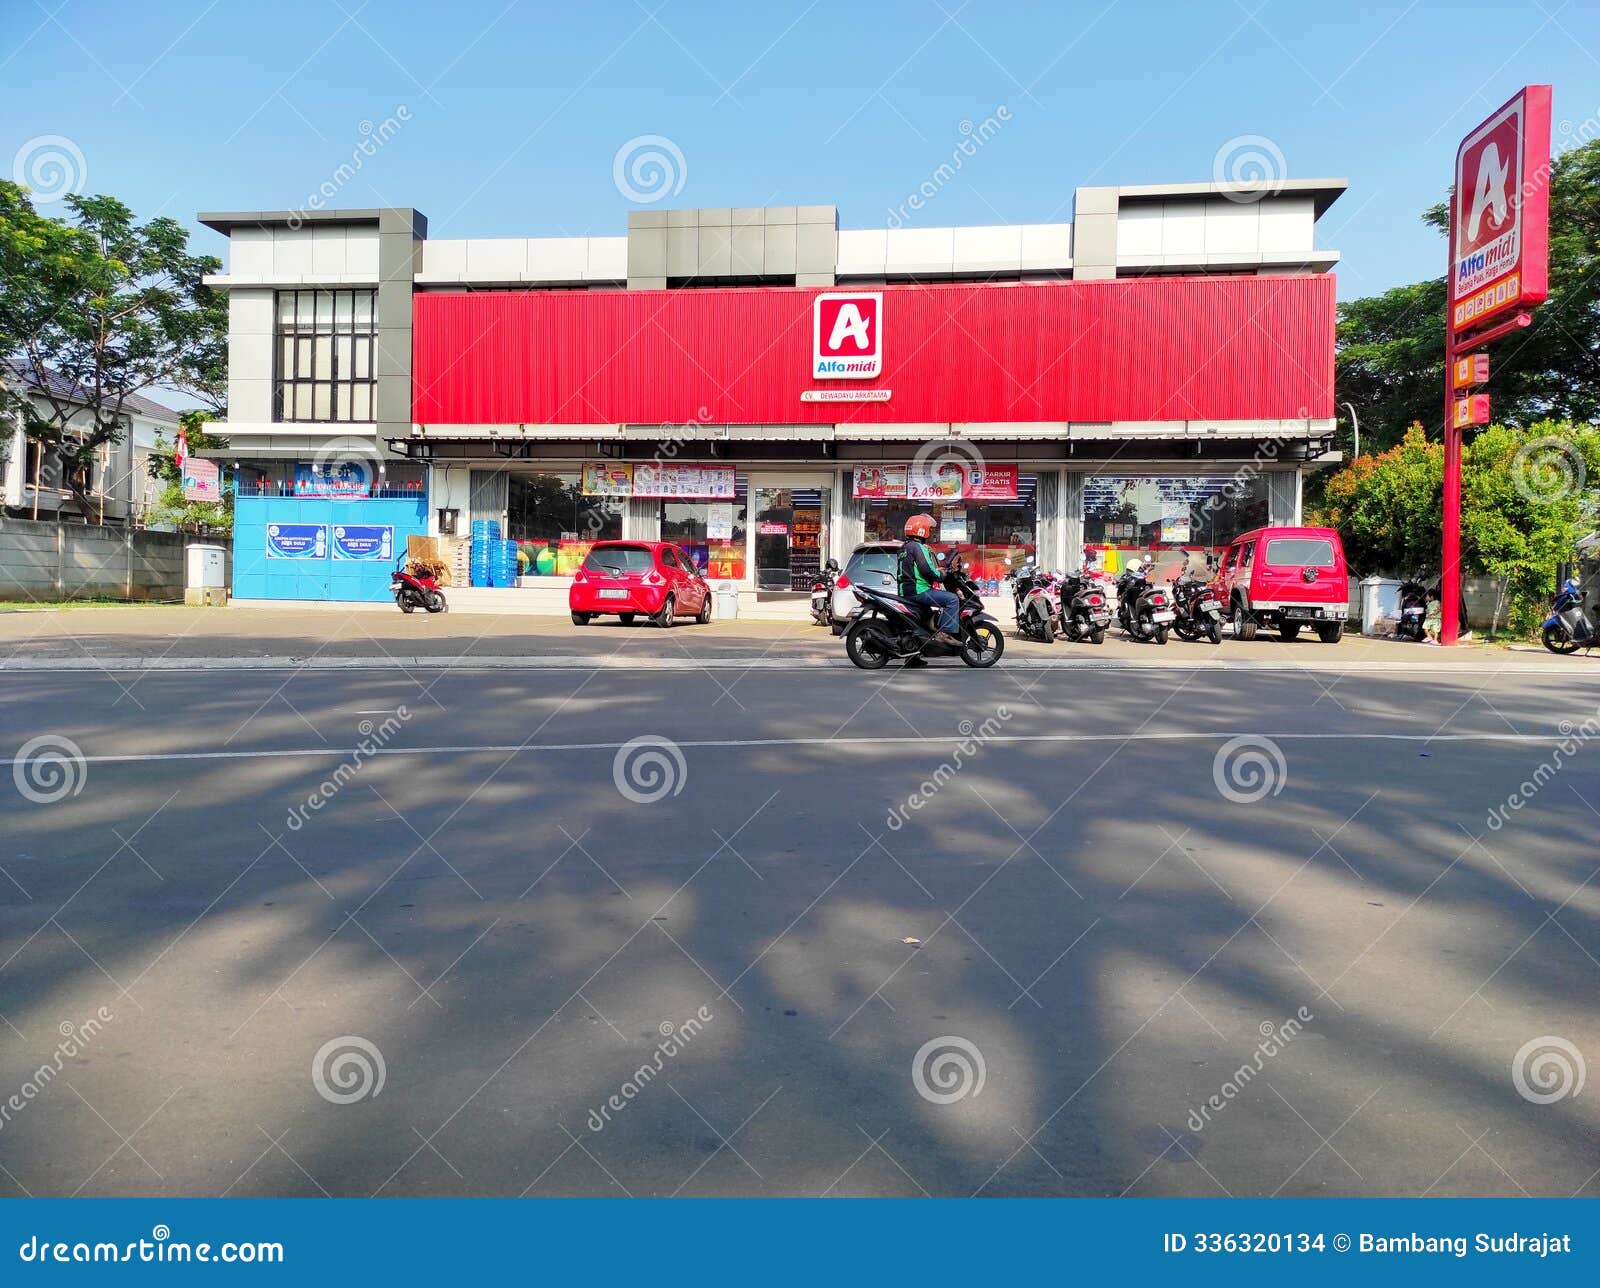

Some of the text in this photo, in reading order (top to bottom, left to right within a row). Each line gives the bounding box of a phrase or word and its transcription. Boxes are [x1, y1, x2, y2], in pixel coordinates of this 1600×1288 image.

[1468, 142, 1509, 242] A
[1458, 231, 1516, 281] Alfamidi
[828, 303, 870, 350] A
[817, 360, 877, 373] Alfamidi
[912, 486, 943, 498] 2.490
